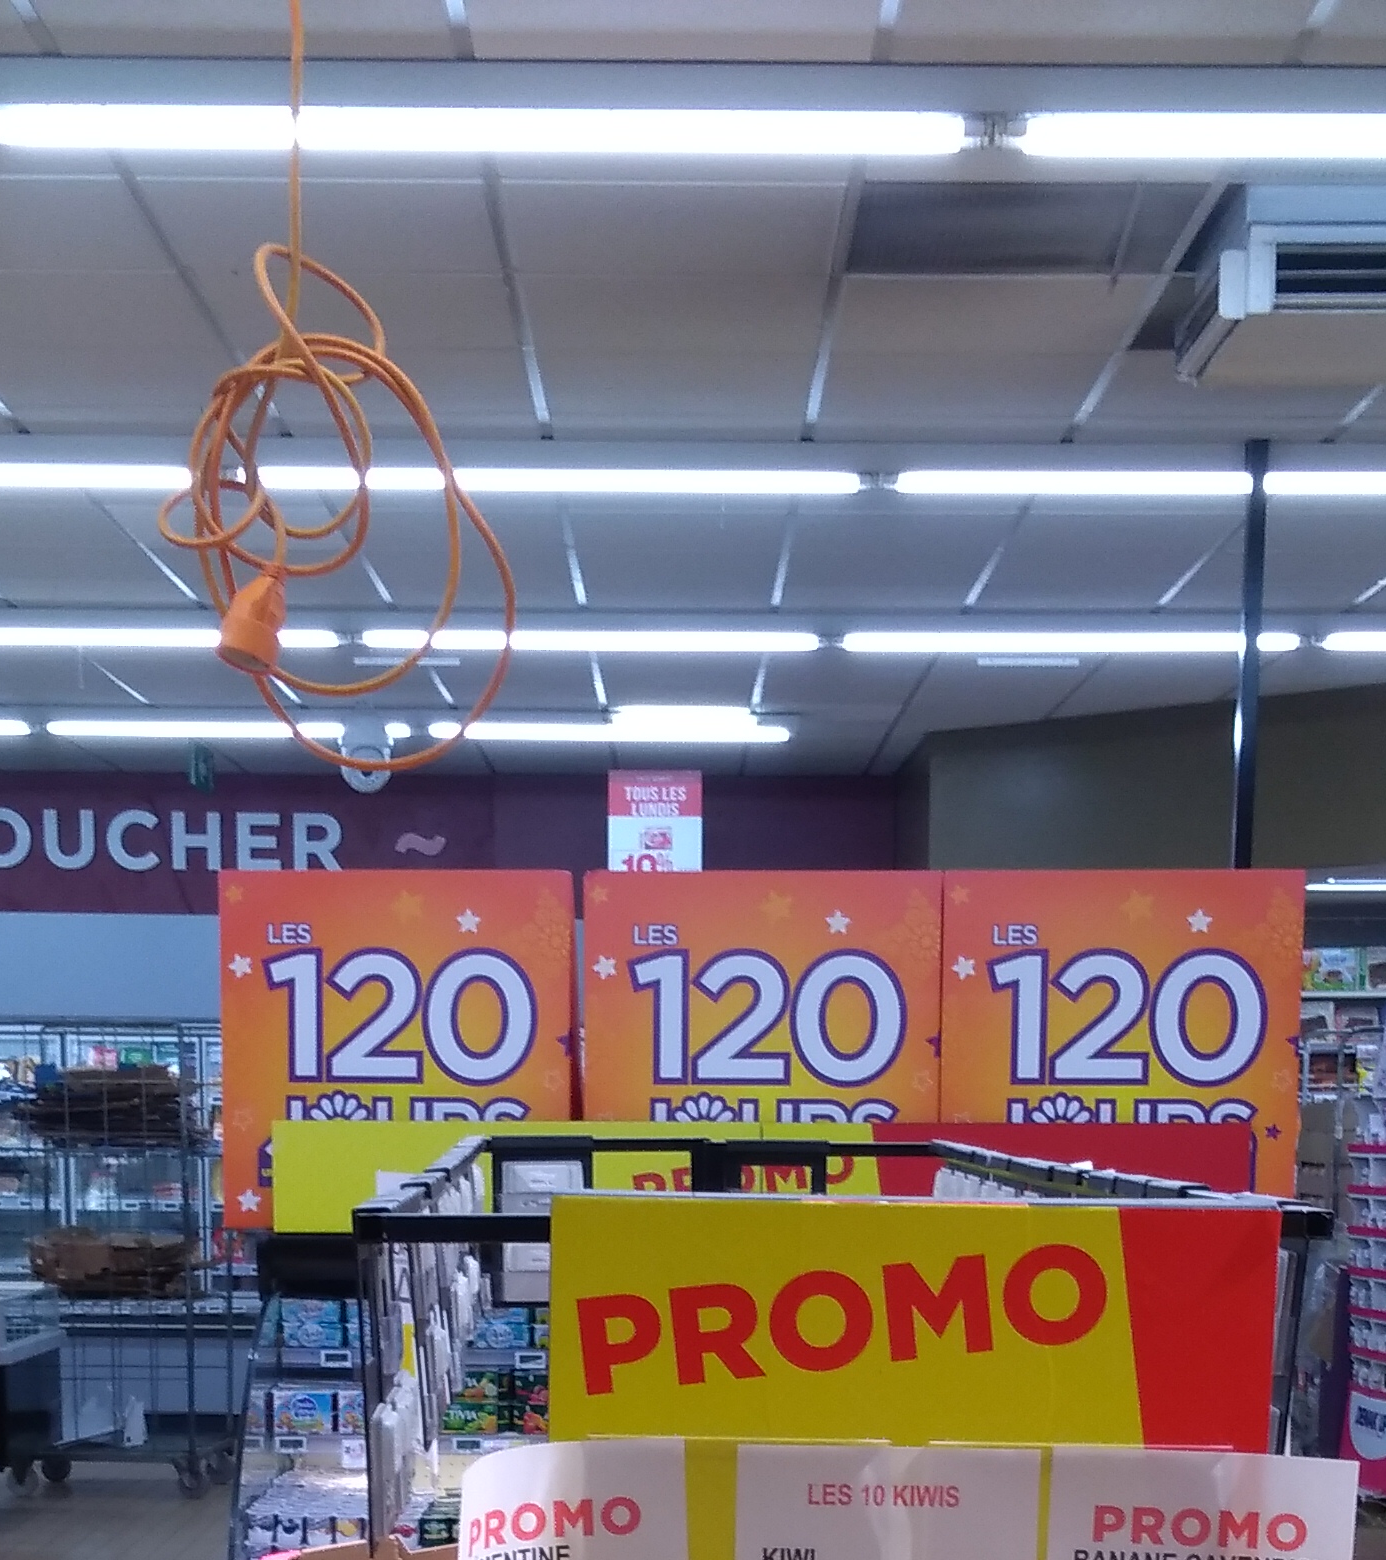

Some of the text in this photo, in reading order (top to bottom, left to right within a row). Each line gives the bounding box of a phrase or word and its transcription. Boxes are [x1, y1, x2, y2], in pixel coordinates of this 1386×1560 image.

[624, 785, 687, 801] TOUS LES
[267, 922, 312, 945] LES
[632, 923, 679, 946] LES
[992, 924, 1039, 946] LES
[262, 946, 538, 1088] 120
[626, 947, 908, 1089] 120
[985, 946, 1269, 1088] 120
[576, 1242, 1109, 1397] PROMO
[808, 1483, 960, 1508] LES 10 KIWIS
[468, 1496, 642, 1557] PROMO
[1092, 1504, 1308, 1552] PROMO
